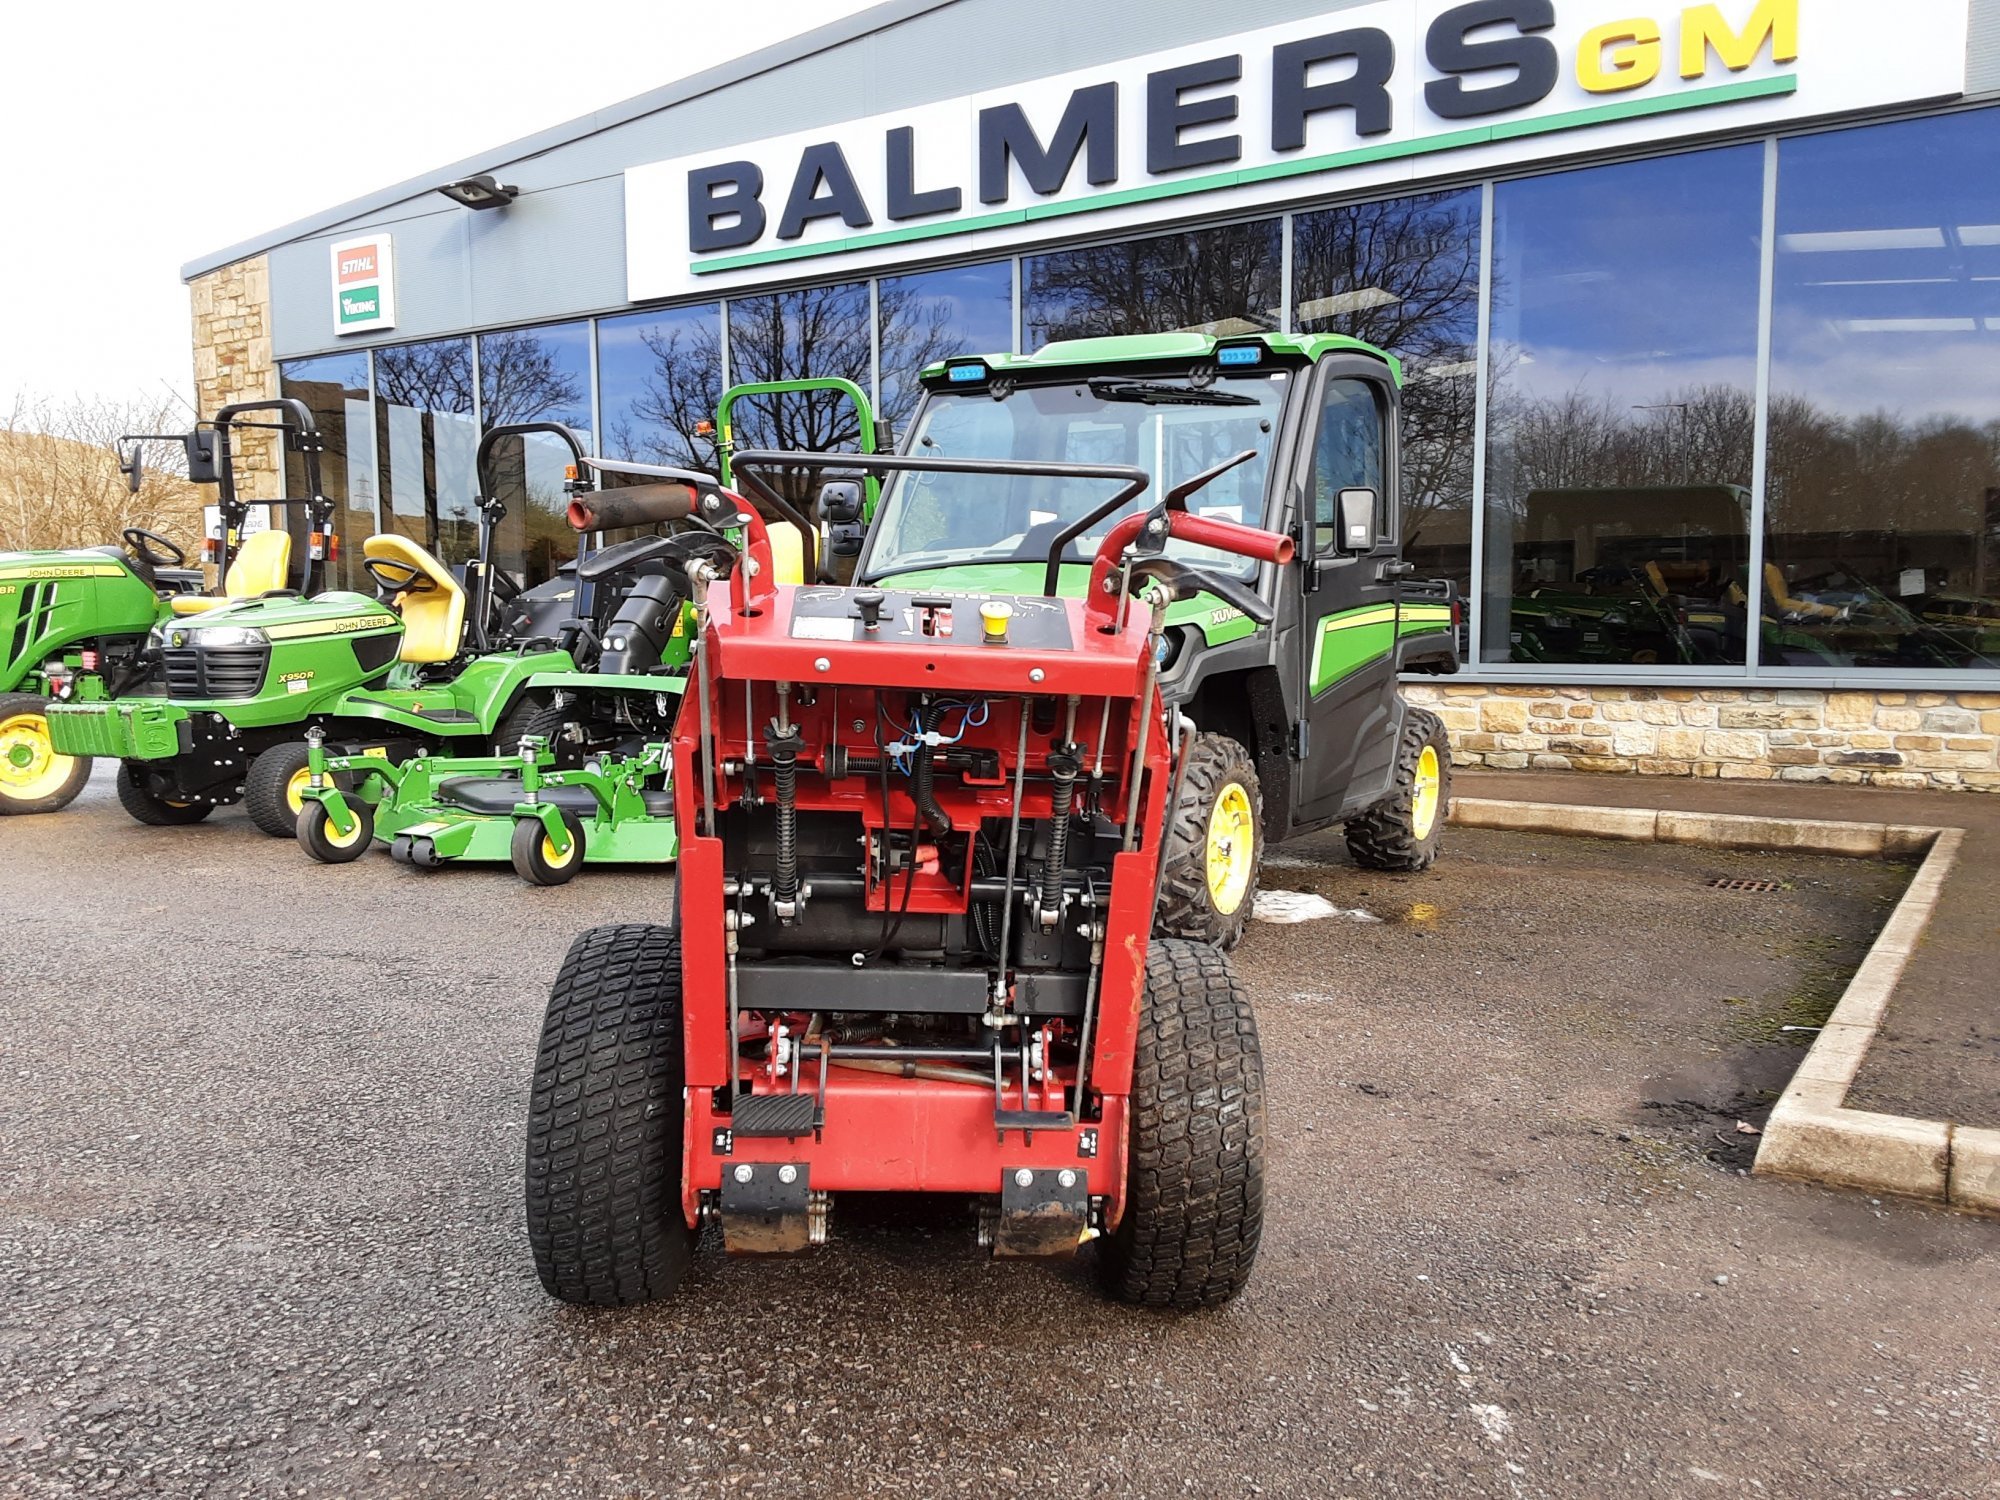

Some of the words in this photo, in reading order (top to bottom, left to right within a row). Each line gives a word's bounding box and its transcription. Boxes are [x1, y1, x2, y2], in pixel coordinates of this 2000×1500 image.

[341, 256, 374, 275] STIHL
[343, 298, 376, 315] VIKING
[28, 569, 53, 577] JOHN
[55, 568, 85, 576] DEERE
[334, 621, 358, 632] JOHN
[360, 618, 387, 628] DEERE
